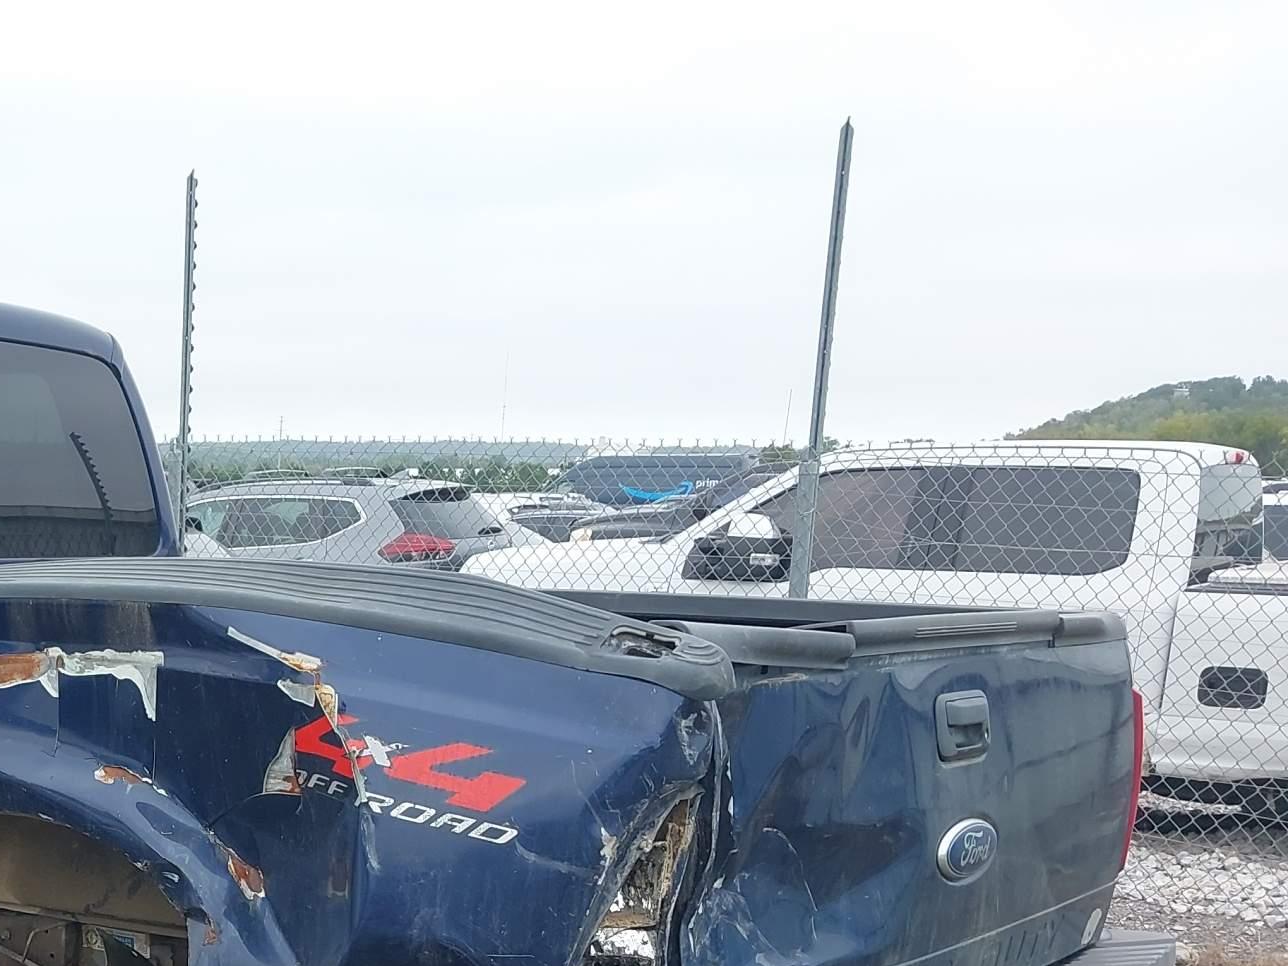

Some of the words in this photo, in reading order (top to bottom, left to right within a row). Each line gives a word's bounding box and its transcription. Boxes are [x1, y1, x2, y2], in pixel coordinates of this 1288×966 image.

[695, 477, 723, 489] prim
[354, 791, 519, 844] ROAD
[960, 831, 991, 867] Ford
